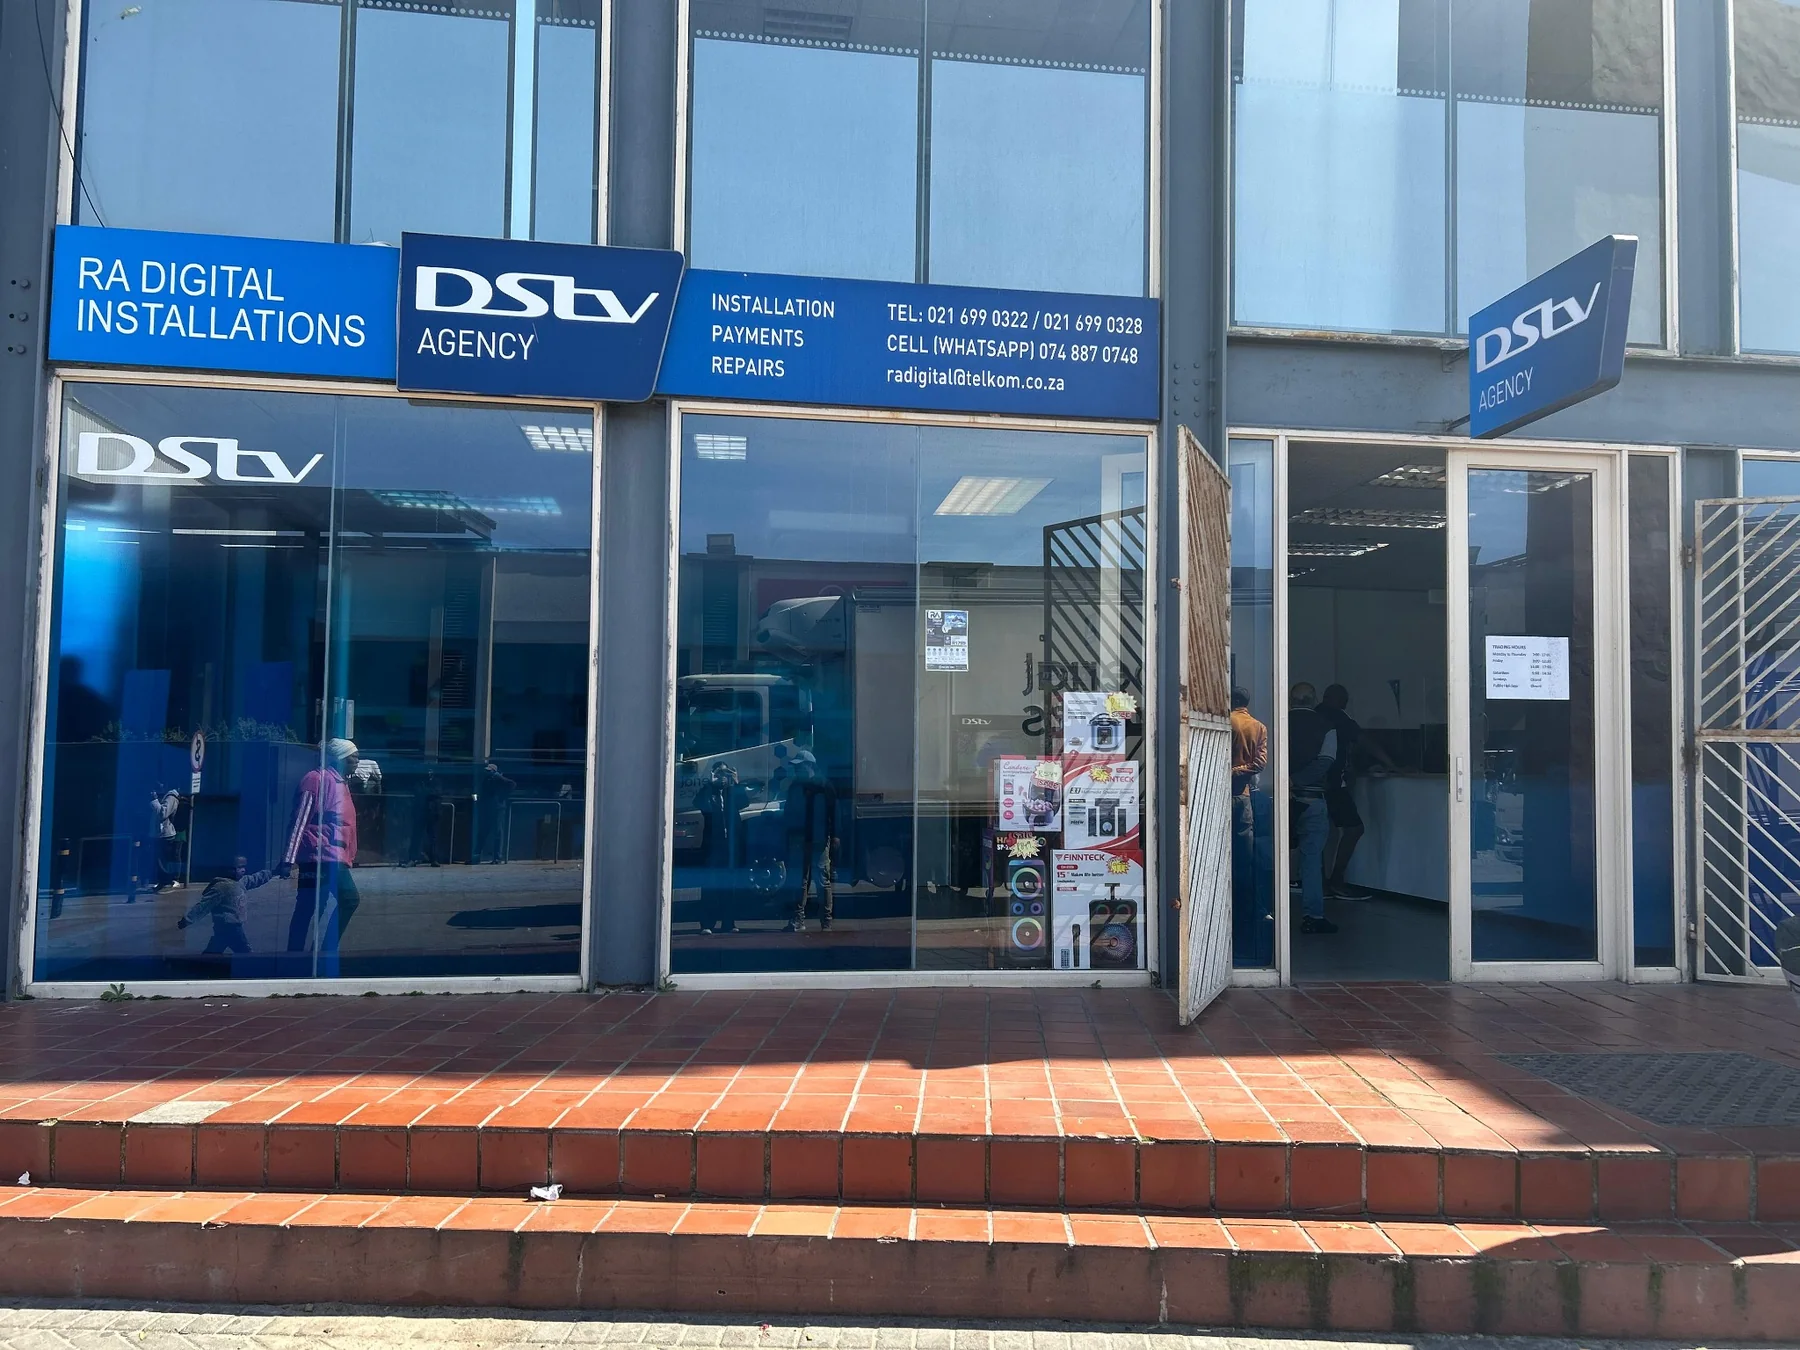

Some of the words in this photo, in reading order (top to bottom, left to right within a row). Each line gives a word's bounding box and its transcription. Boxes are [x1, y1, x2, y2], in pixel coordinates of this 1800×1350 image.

[78, 257, 131, 292] RA
[141, 260, 284, 302] DIGITAL
[416, 265, 660, 324] DStv
[712, 293, 835, 318] INSTALLATION
[887, 303, 923, 322] TEL:
[928, 306, 954, 324] 021
[960, 308, 988, 326] 699
[992, 310, 1028, 329] 0322
[1032, 311, 1040, 331] /
[1044, 313, 1069, 331] 021
[1076, 315, 1102, 332] 699
[1107, 316, 1143, 334] 0328
[77, 299, 367, 348] INSTALLATIONS
[712, 325, 804, 347] PAYMENTS
[1476, 281, 1601, 374] DStv
[417, 327, 535, 361] AGENCY
[887, 334, 929, 354] CELL
[934, 335, 1035, 360] (WHATSAPP)
[1040, 342, 1067, 361] 074
[1071, 344, 1098, 362] 887
[1102, 346, 1138, 364] 0748
[712, 356, 785, 377] REPAIRS
[887, 366, 1065, 391] radigital@telkom.co.za
[1478, 366, 1534, 413] AGENCY
[78, 432, 324, 484] DStv
